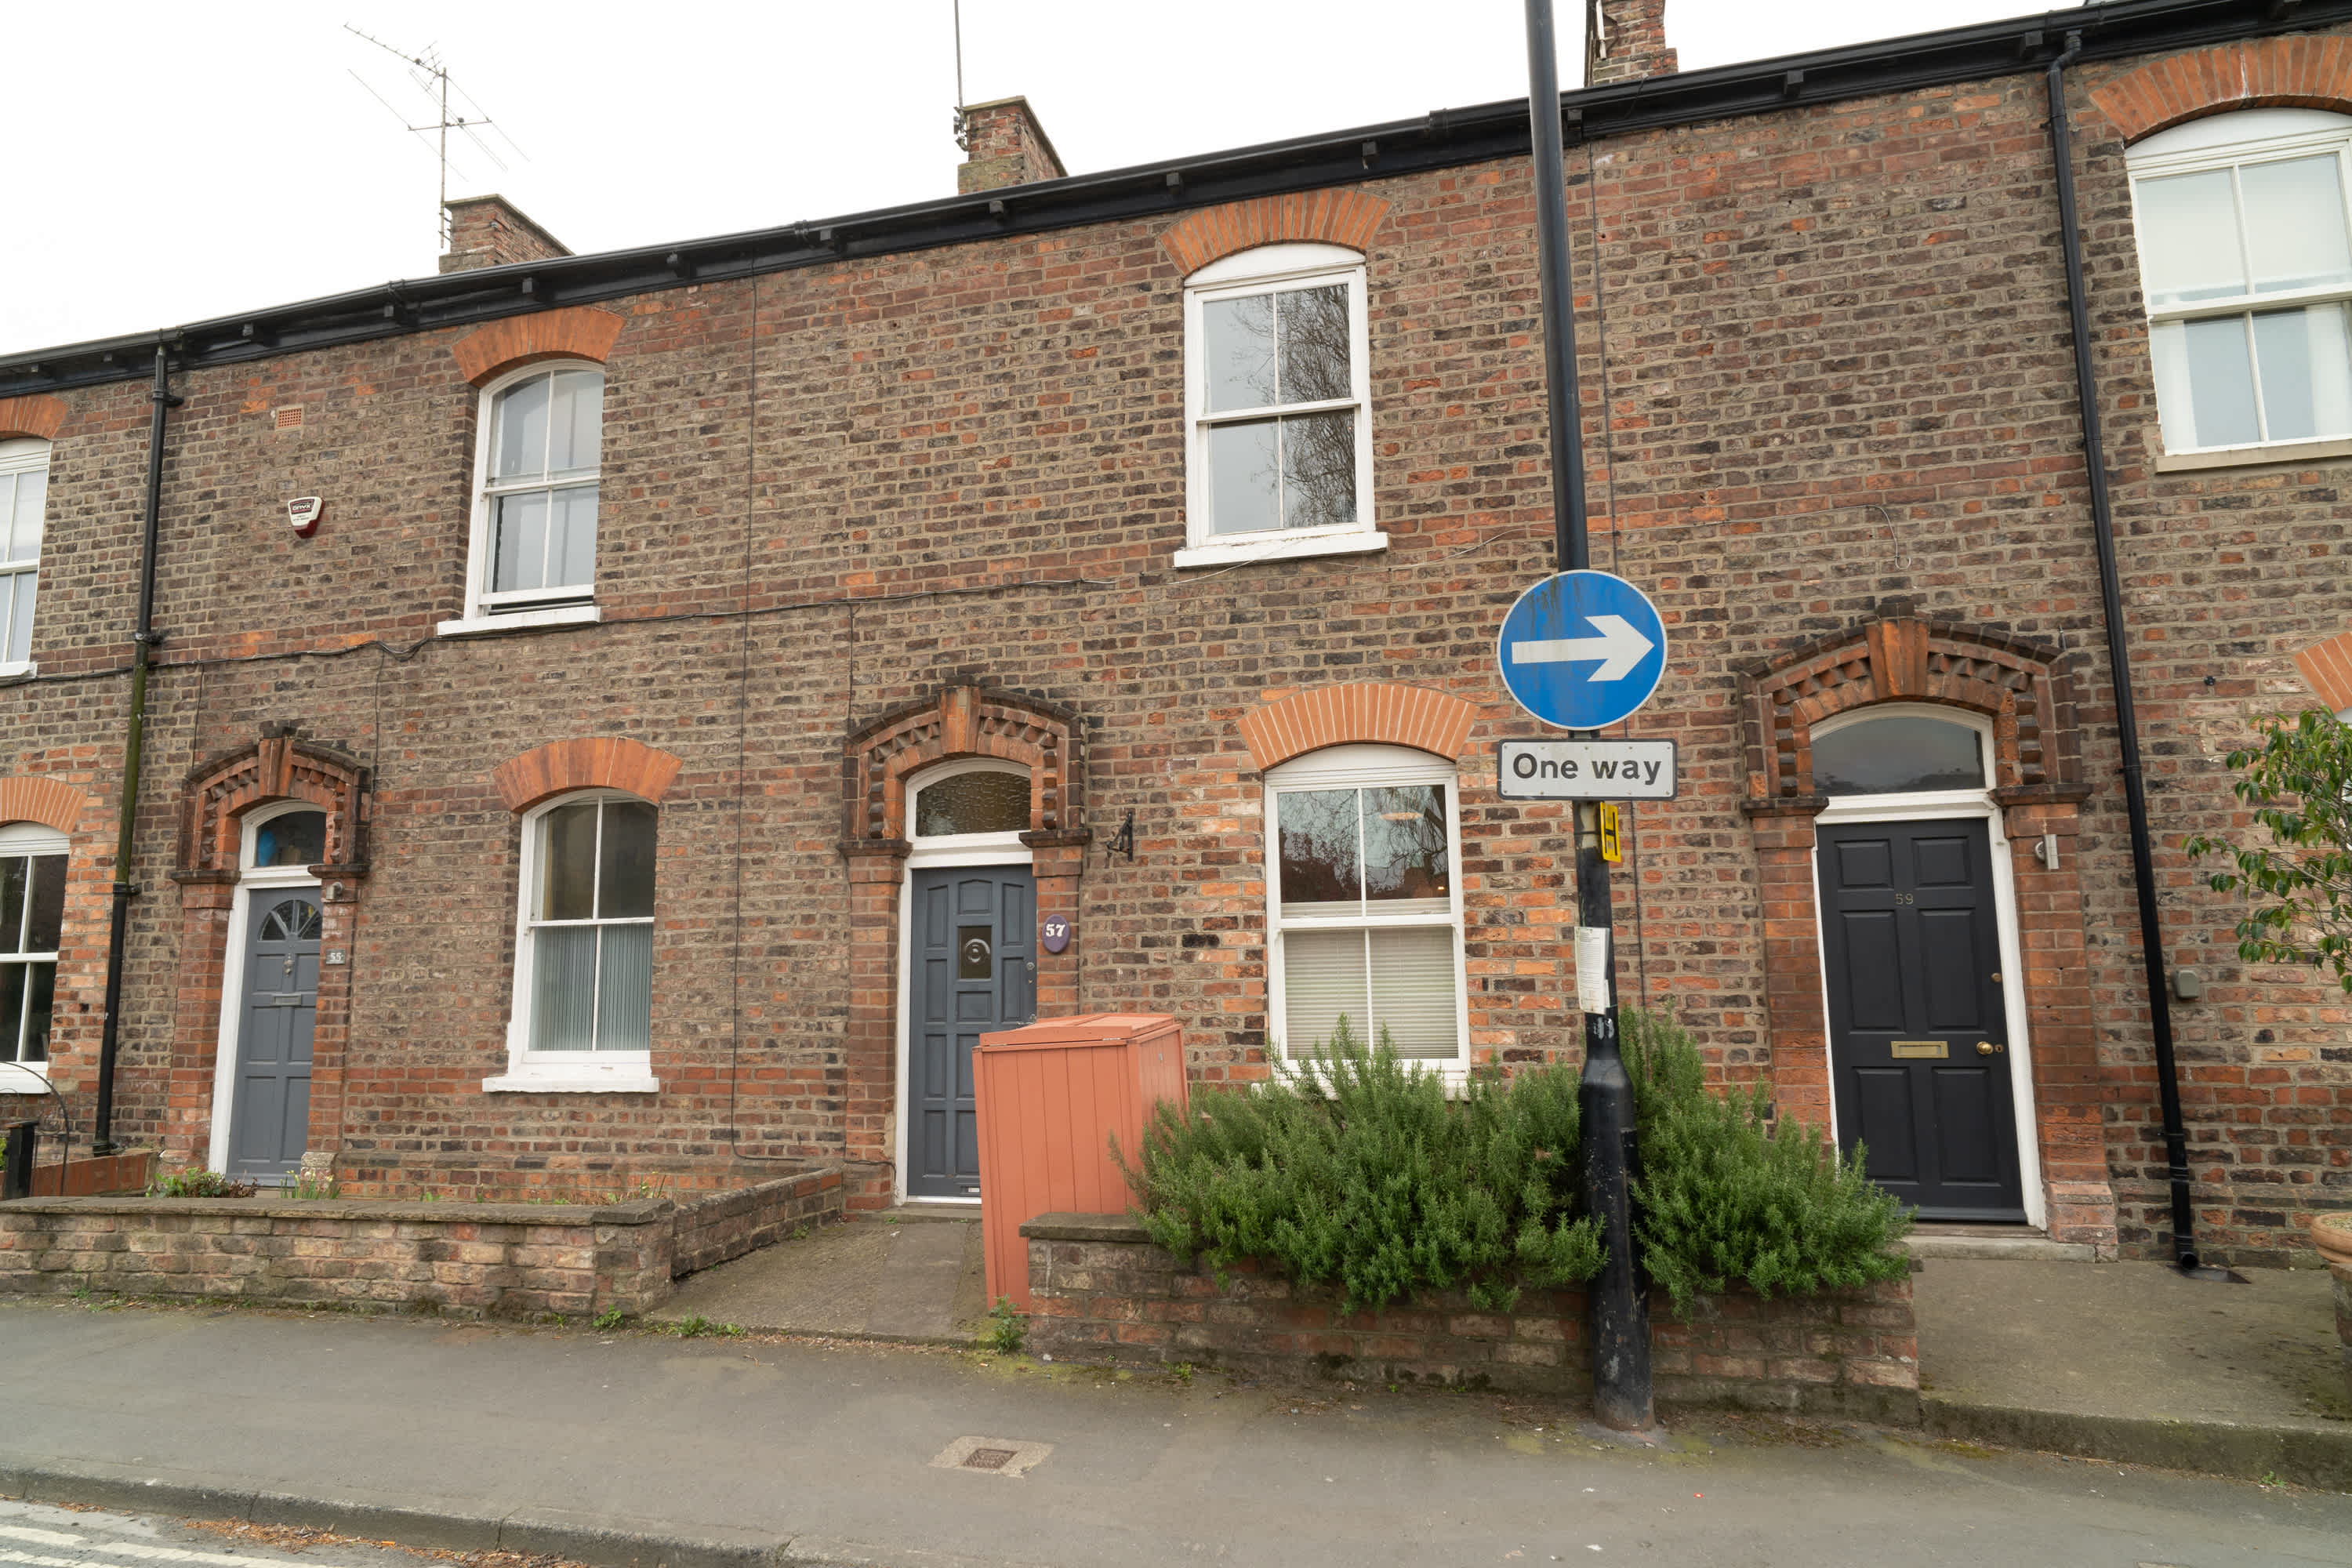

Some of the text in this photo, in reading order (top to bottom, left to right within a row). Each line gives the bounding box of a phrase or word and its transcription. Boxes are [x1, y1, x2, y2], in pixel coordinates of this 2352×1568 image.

[1512, 753, 1661, 786] One way
[1895, 893, 1914, 906] 59
[1045, 923, 1066, 938] 57
[329, 952, 343, 961] 55
